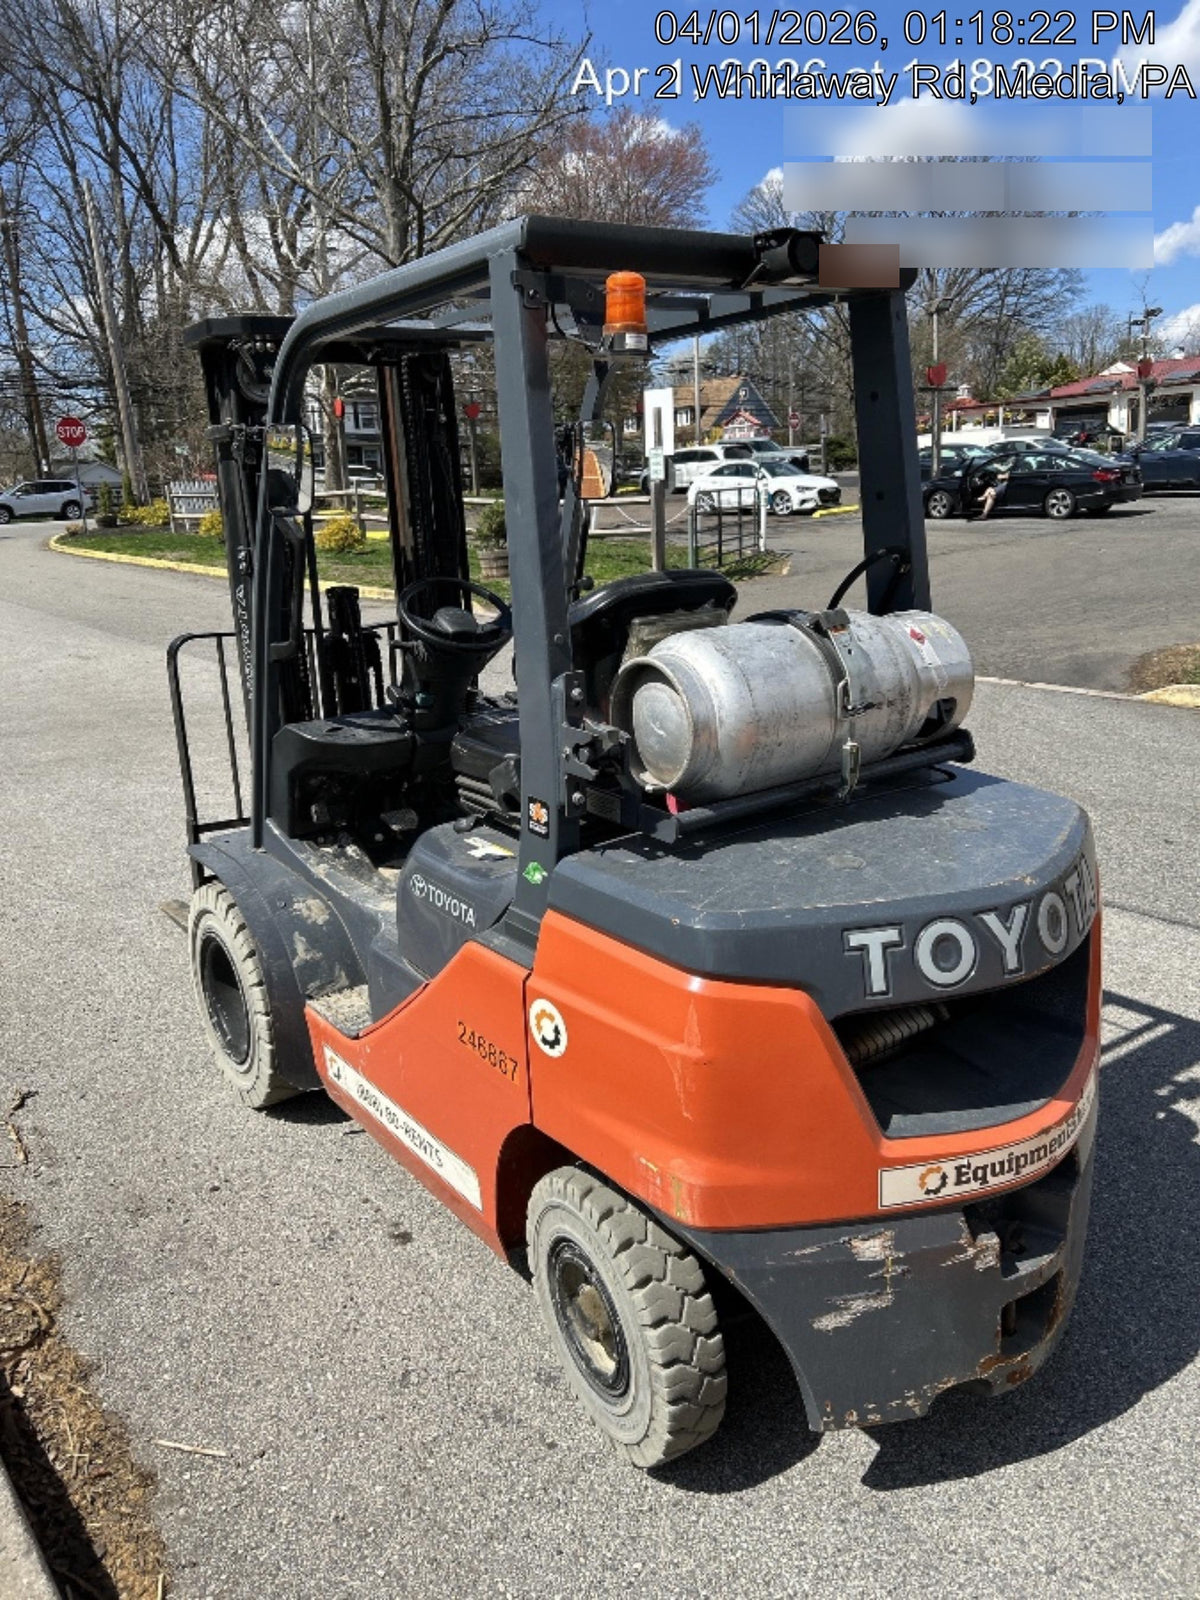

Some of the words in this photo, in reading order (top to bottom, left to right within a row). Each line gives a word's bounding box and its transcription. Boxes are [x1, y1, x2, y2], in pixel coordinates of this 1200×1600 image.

[57, 426, 84, 438] STOP
[428, 884, 477, 928] TOYOTA
[841, 853, 1097, 999] TOYOTA
